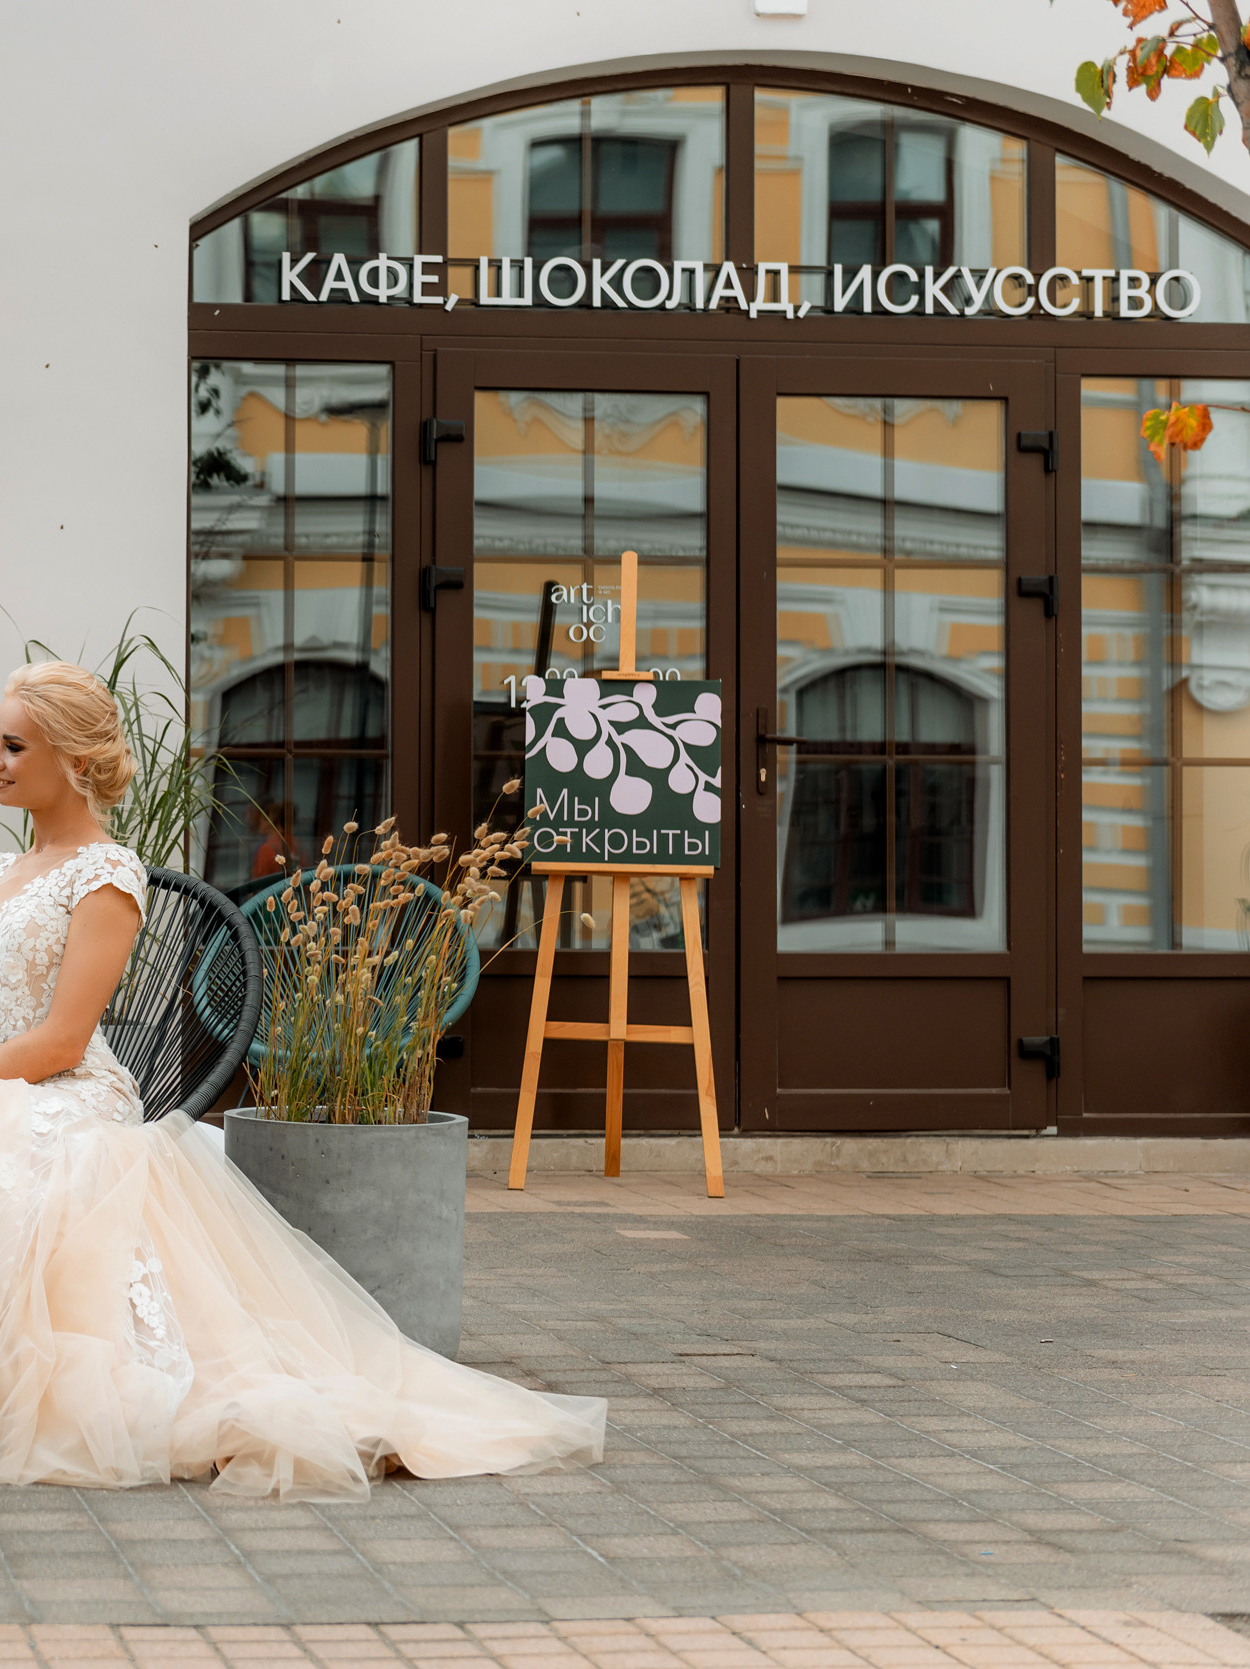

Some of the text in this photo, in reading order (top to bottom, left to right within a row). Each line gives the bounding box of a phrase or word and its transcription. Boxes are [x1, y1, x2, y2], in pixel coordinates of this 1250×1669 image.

[281, 251, 1201, 319] КАФЕ, ШОКОЛАД, ИСКУССТВО
[551, 582, 594, 604] art
[568, 623, 606, 643] oc
[536, 788, 599, 821] Мы
[534, 827, 709, 861] открыты
